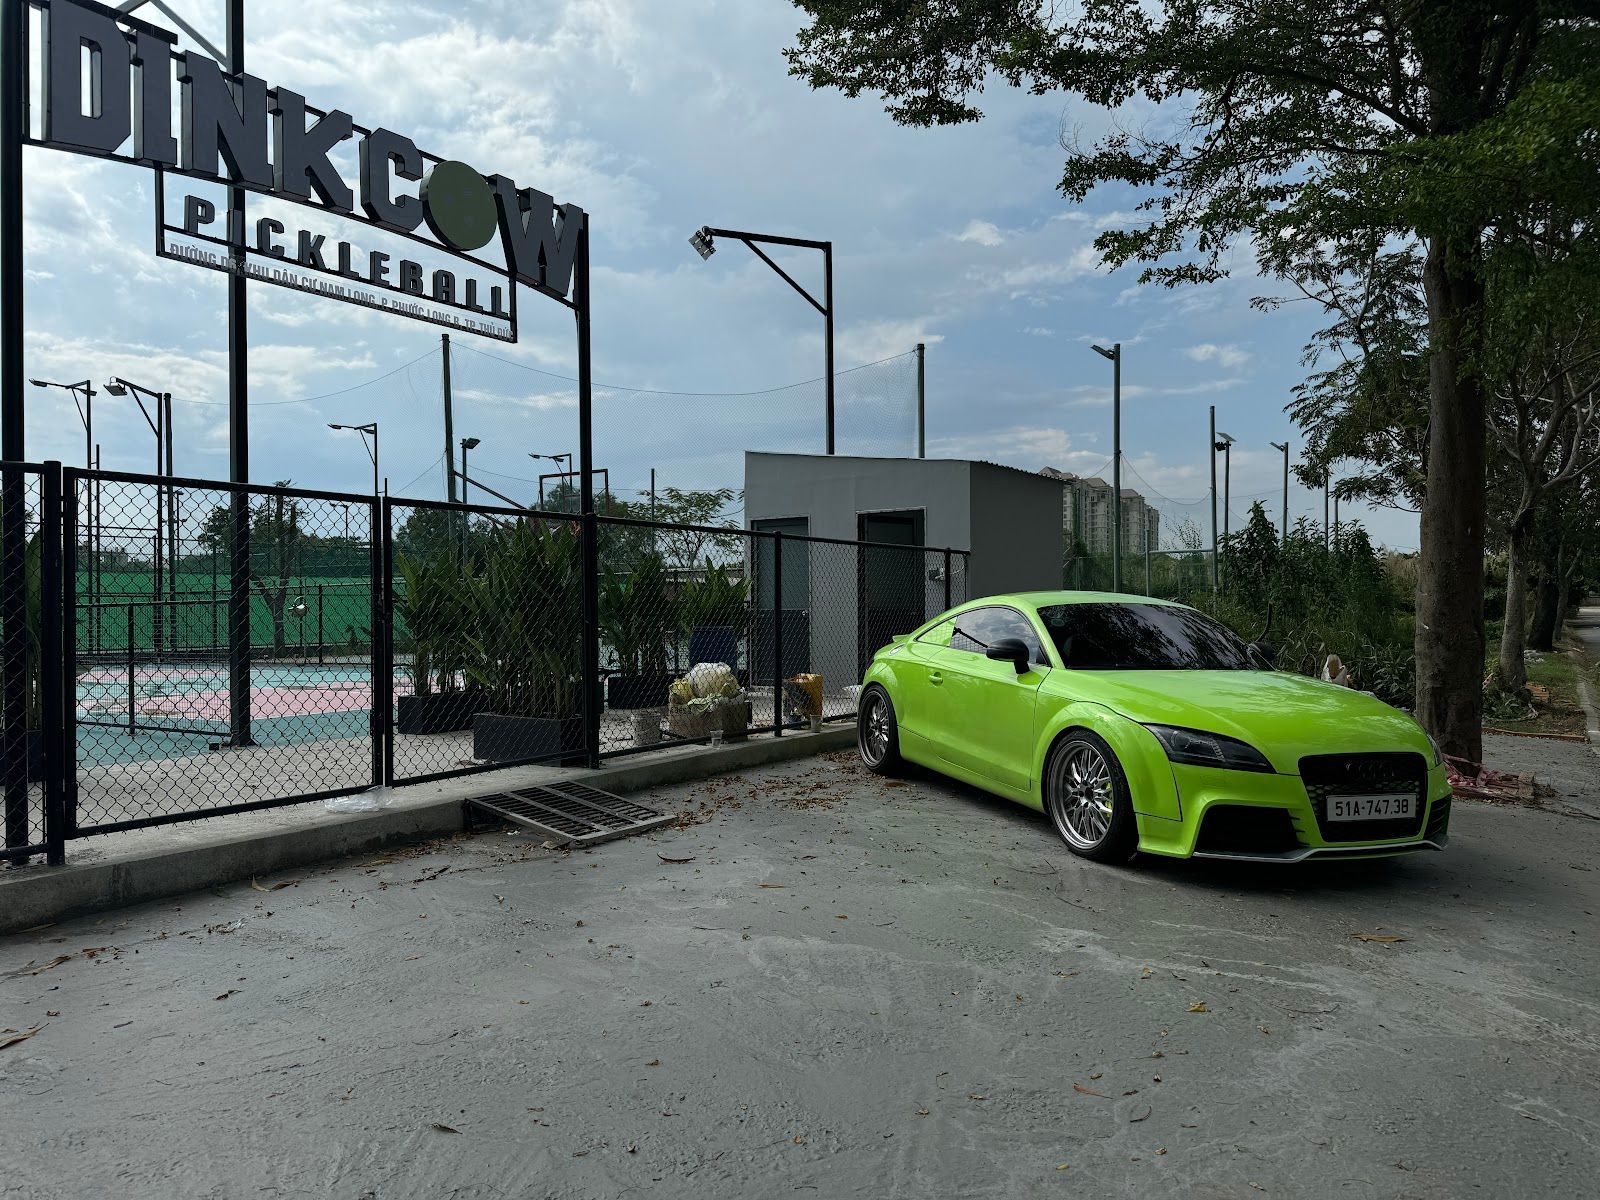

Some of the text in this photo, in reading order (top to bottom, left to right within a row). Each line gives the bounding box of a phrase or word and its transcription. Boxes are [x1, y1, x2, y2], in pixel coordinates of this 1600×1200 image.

[170, 243, 217, 267] ĐƯỜNG
[243, 261, 269, 282] KHU
[273, 268, 298, 289] DÂN
[301, 276, 318, 293] CƯ
[320, 281, 345, 299] NAM
[392, 300, 424, 319] PHƯỚC
[427, 309, 451, 326] LONG
[184, 194, 509, 317] PICKLEBALL
[1335, 798, 1409, 817] 51A-747.38
